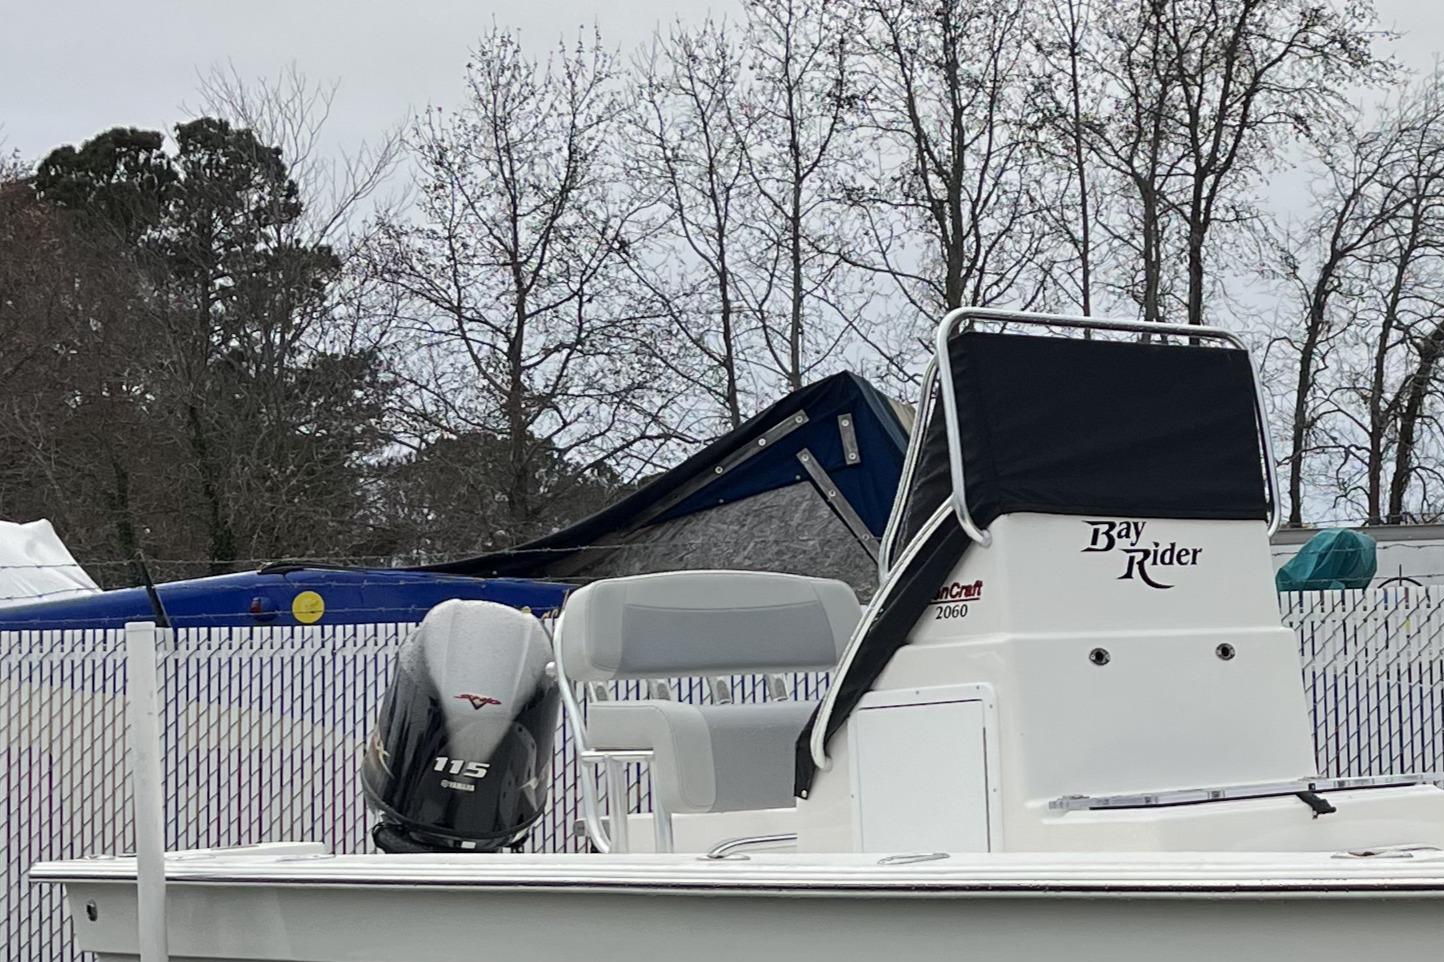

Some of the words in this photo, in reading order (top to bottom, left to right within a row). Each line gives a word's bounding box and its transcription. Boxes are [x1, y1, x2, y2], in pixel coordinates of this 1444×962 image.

[1080, 520, 1146, 552] Bay
[1115, 541, 1203, 589] Rider
[935, 604, 968, 619] 2060
[434, 757, 490, 778] 115
